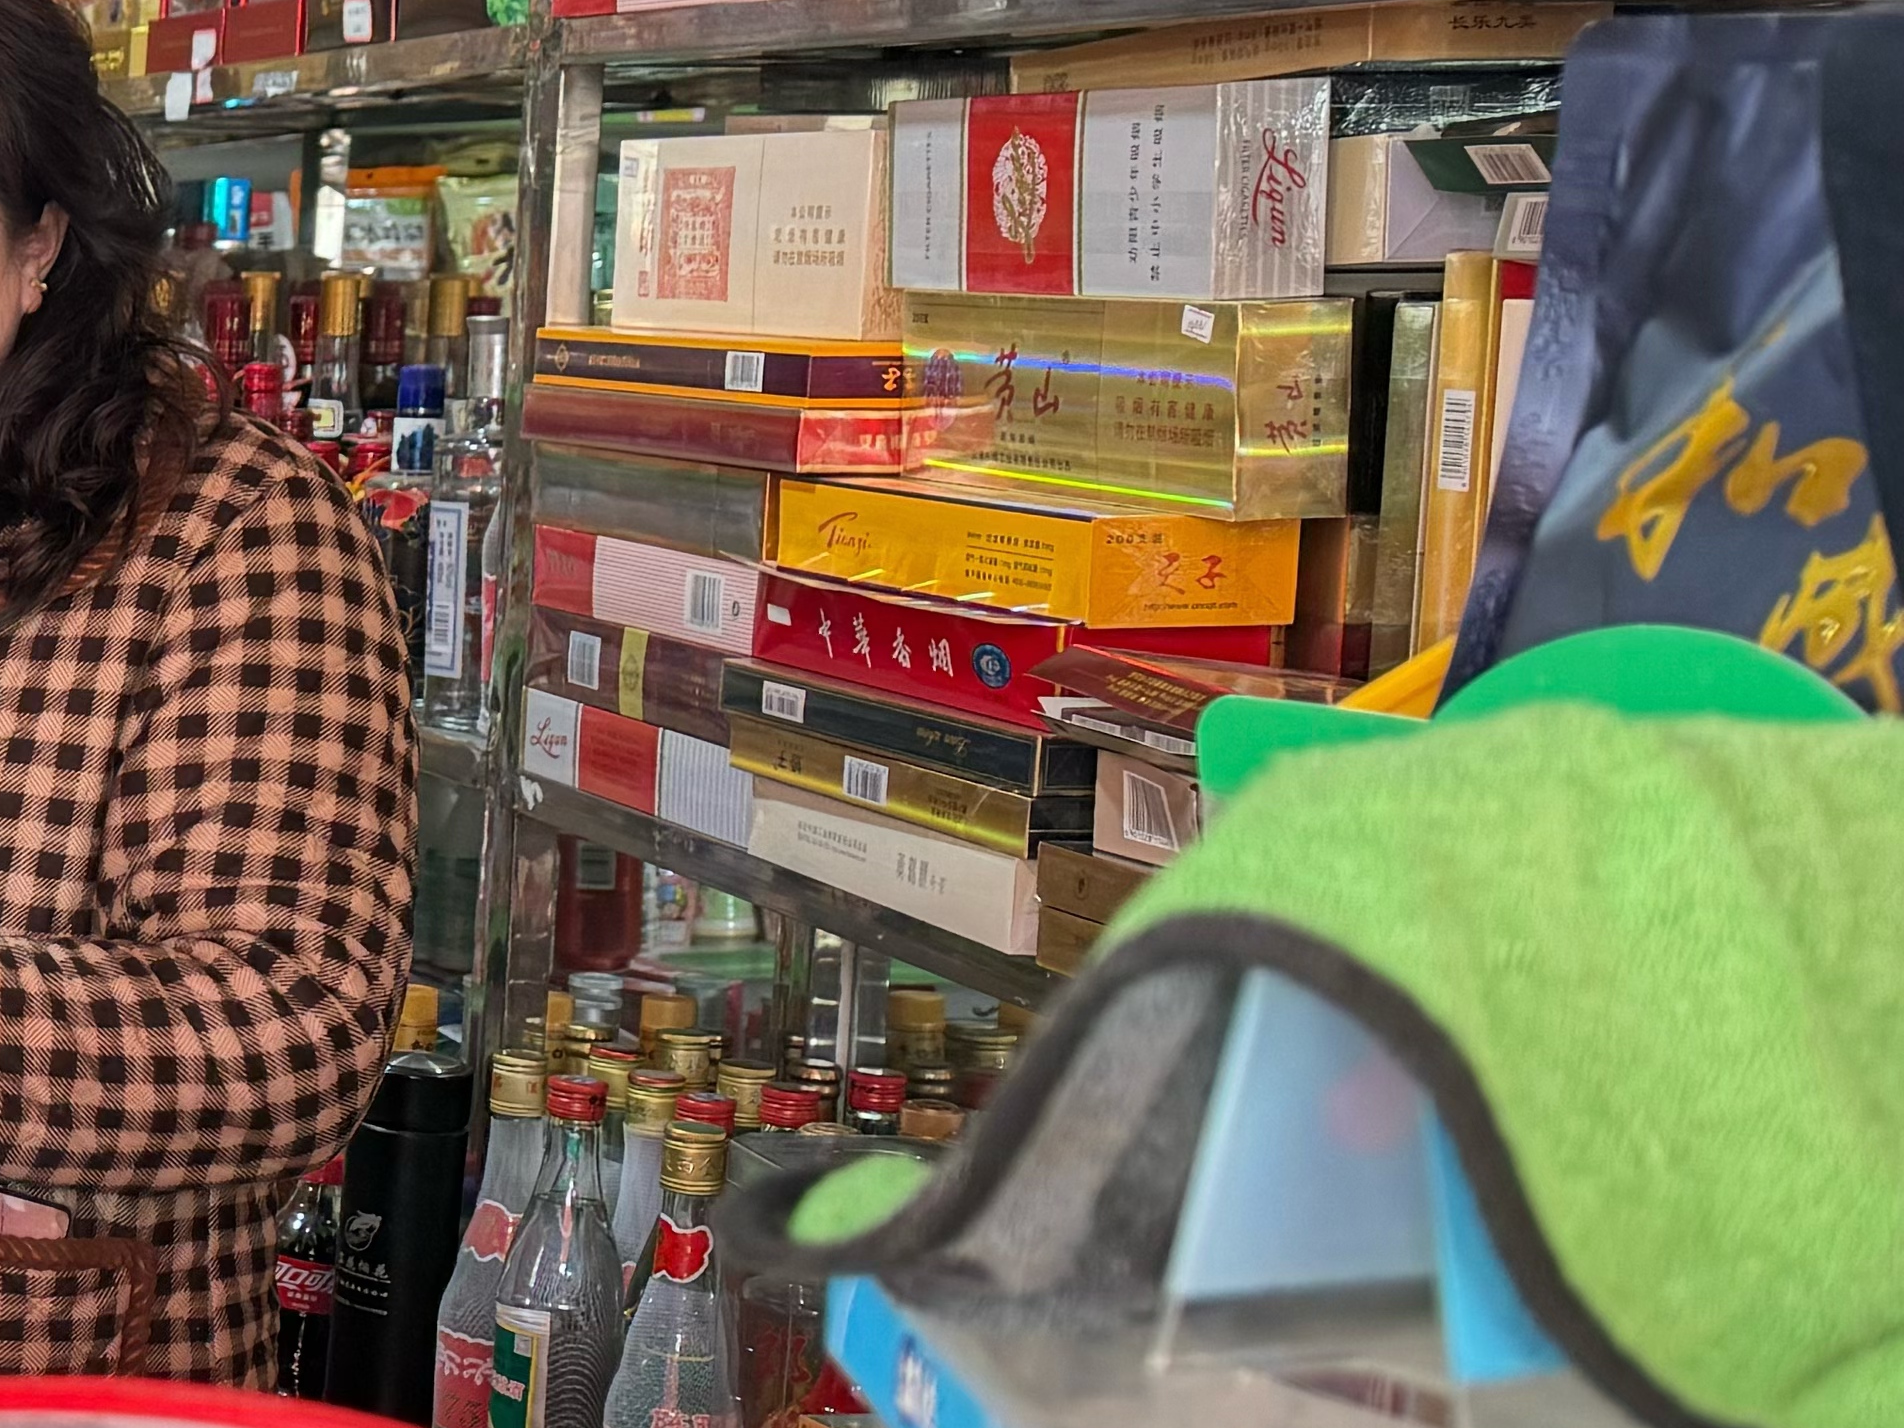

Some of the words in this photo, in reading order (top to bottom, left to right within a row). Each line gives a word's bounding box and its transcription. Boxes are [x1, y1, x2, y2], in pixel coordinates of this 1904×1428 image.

[1128, 120, 1144, 263] 劝阻青少年吸烟
[1149, 103, 1167, 282] 禁止中小学生吸烟
